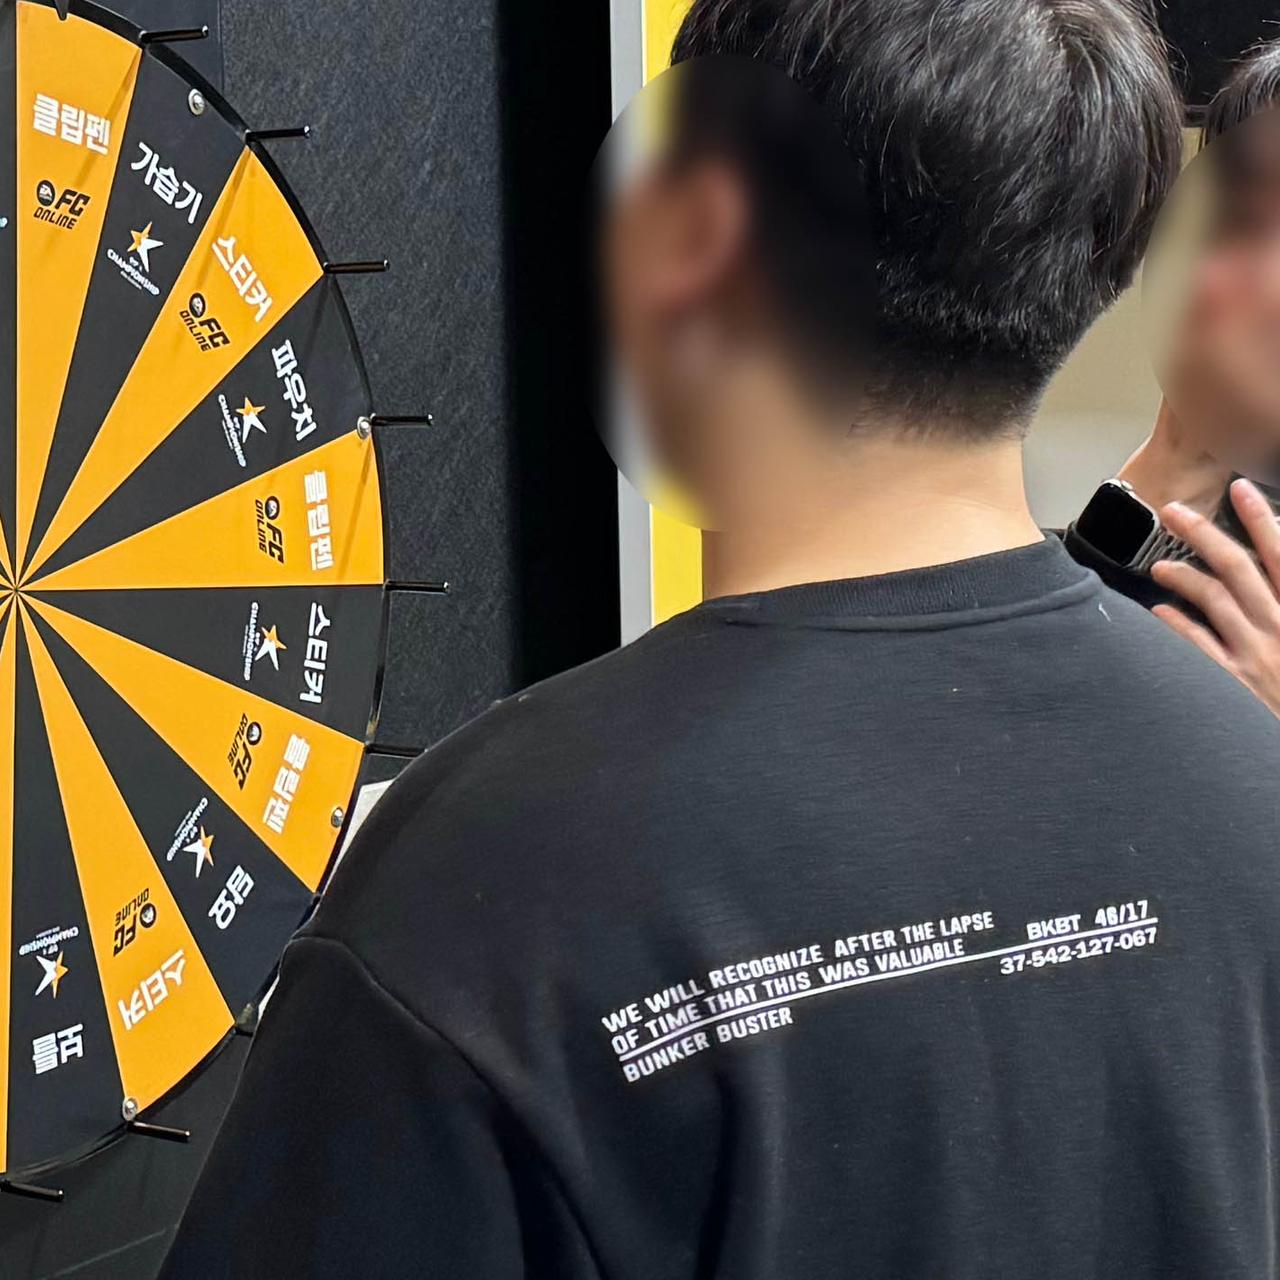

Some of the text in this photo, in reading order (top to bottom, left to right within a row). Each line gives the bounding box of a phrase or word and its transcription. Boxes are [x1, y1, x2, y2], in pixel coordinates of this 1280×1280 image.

[32, 93, 111, 155] 클립펜
[55, 188, 91, 217] FC
[130, 141, 204, 224] 가습기
[211, 235, 273, 323] 스티커
[198, 317, 230, 350] FC
[272, 339, 317, 441] 파우치
[266, 522, 284, 564] FC
[303, 470, 335, 571] 클립펜
[299, 602, 333, 704] 스티커
[232, 746, 254, 791] FC
[262, 733, 311, 835] 클립펜
[208, 865, 255, 930] 담요
[1026, 913, 1081, 941] BKBT
[113, 923, 143, 956] FC
[602, 910, 995, 1034] WE WILL RECOGNIZE AFTER THE LAPSE
[1000, 927, 1158, 975] 37-542-127-067
[118, 948, 188, 1030] 스티커
[611, 939, 965, 1056] OF TIME THAT THIS WAS VALUABLE
[32, 1023, 84, 1075] 보틀
[622, 1006, 794, 1083] BUNKER BUSTER
